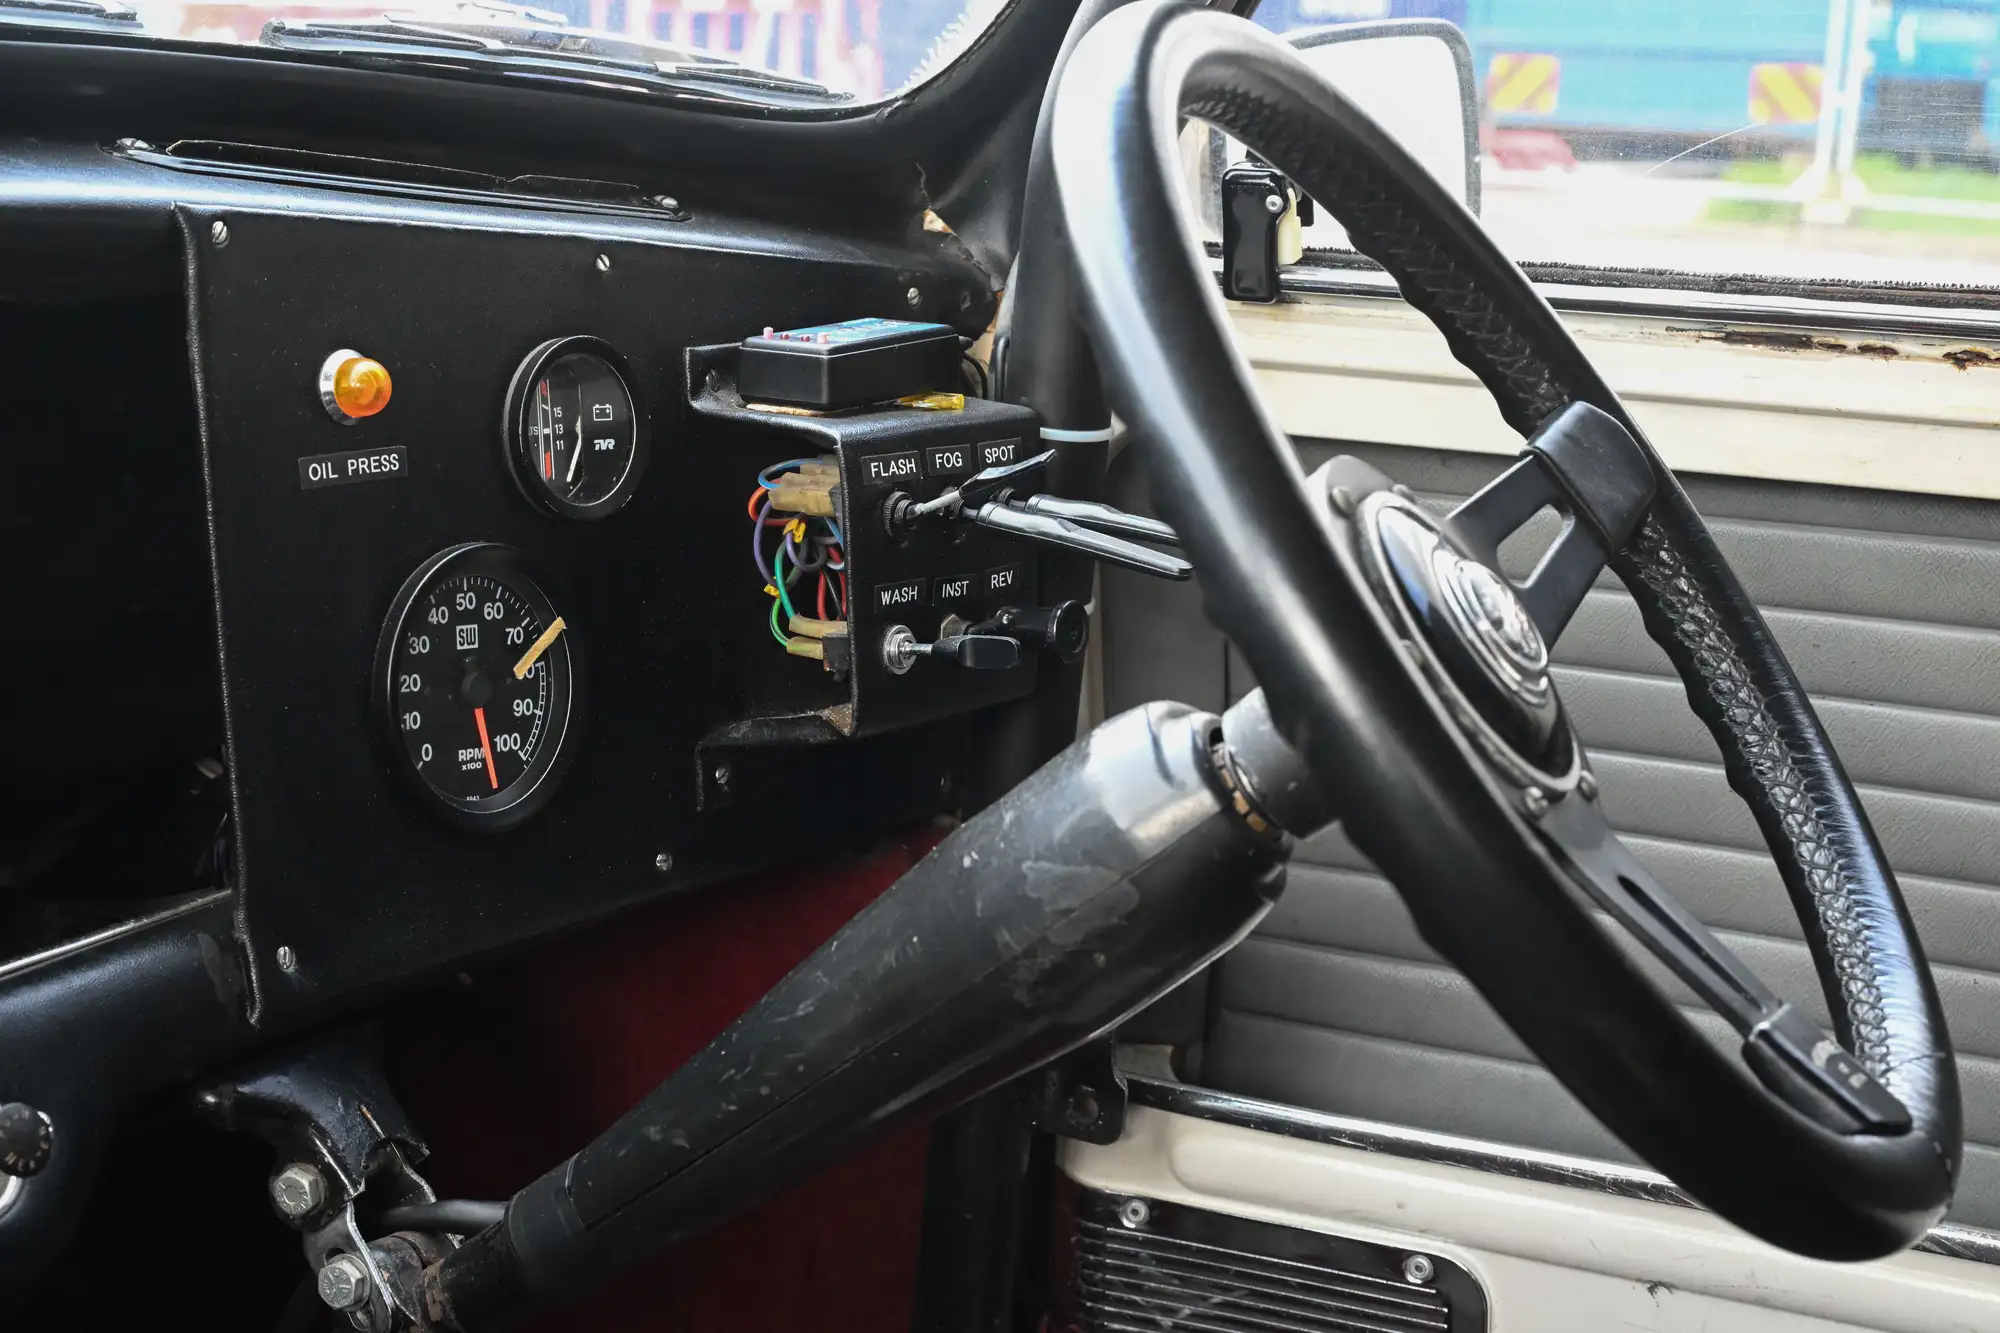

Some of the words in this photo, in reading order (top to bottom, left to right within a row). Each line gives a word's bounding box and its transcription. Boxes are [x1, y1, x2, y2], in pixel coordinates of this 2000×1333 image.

[553, 406, 563, 418] 15
[554, 423, 564, 435] 13
[555, 439, 564, 451] 11
[593, 438, 616, 451] TVR
[985, 444, 1015, 464] SPOT
[308, 463, 339, 481] OIL
[347, 453, 400, 476] PRESS
[870, 458, 917, 478] FLASH
[935, 451, 963, 469] FOG
[941, 580, 970, 598] INST
[991, 570, 1014, 589] REV
[456, 591, 477, 611] 50
[880, 585, 918, 606] WASH
[427, 606, 449, 625] 40
[483, 601, 504, 621] 60
[408, 635, 430, 655] 30
[458, 626, 477, 647] SW
[505, 626, 524, 645] 70
[400, 673, 421, 693] 20
[512, 698, 533, 717] 90
[403, 711, 421, 730] 10
[493, 732, 521, 752] 100
[421, 743, 433, 762] 0
[458, 747, 486, 762] RPM
[461, 761, 483, 771] x100
